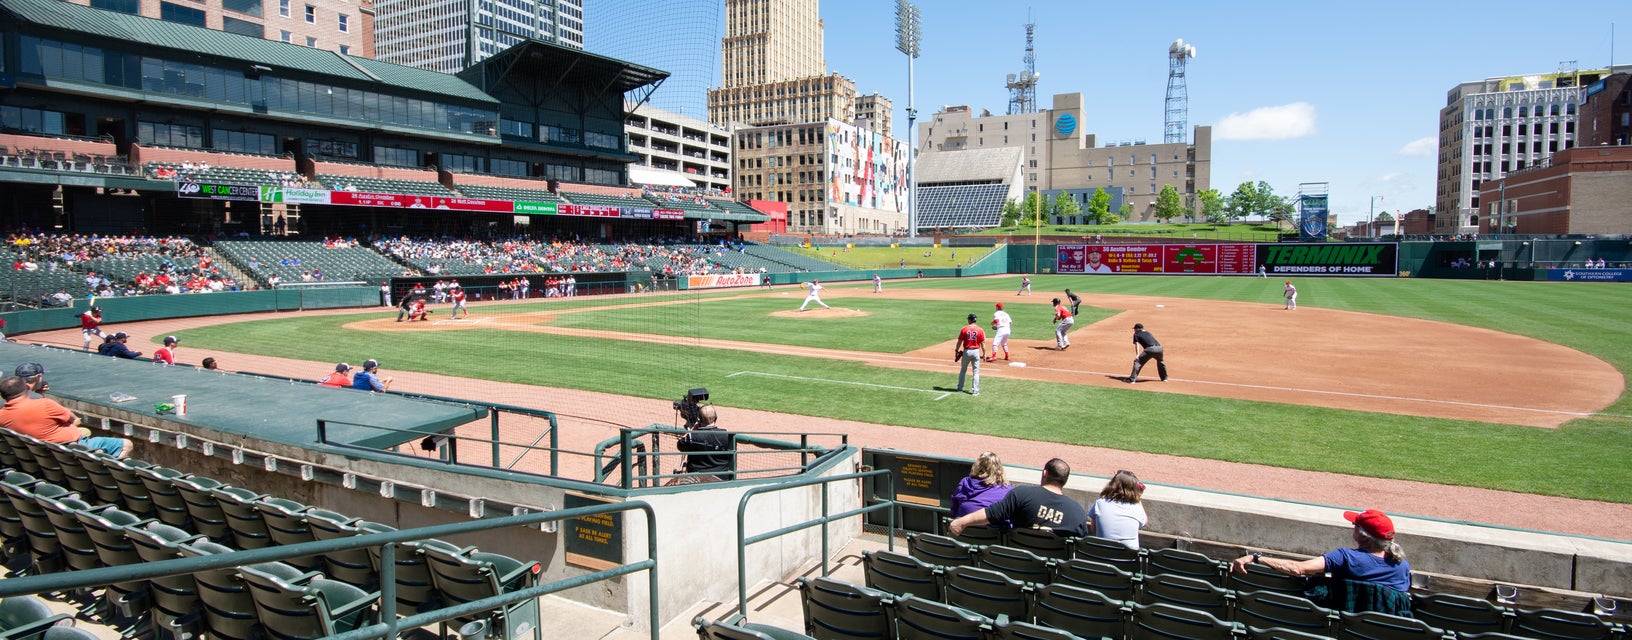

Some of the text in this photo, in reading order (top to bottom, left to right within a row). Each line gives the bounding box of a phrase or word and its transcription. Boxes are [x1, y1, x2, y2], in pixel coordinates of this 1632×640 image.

[202, 184, 258, 196] WEST CANCER CENTER
[286, 189, 314, 198] Holiday
[1265, 245, 1385, 264] TERMINIX
[716, 275, 754, 286] AutoZone
[966, 330, 977, 340] 12
[581, 516, 600, 524] PLAYING
[1037, 505, 1064, 524] DAD
